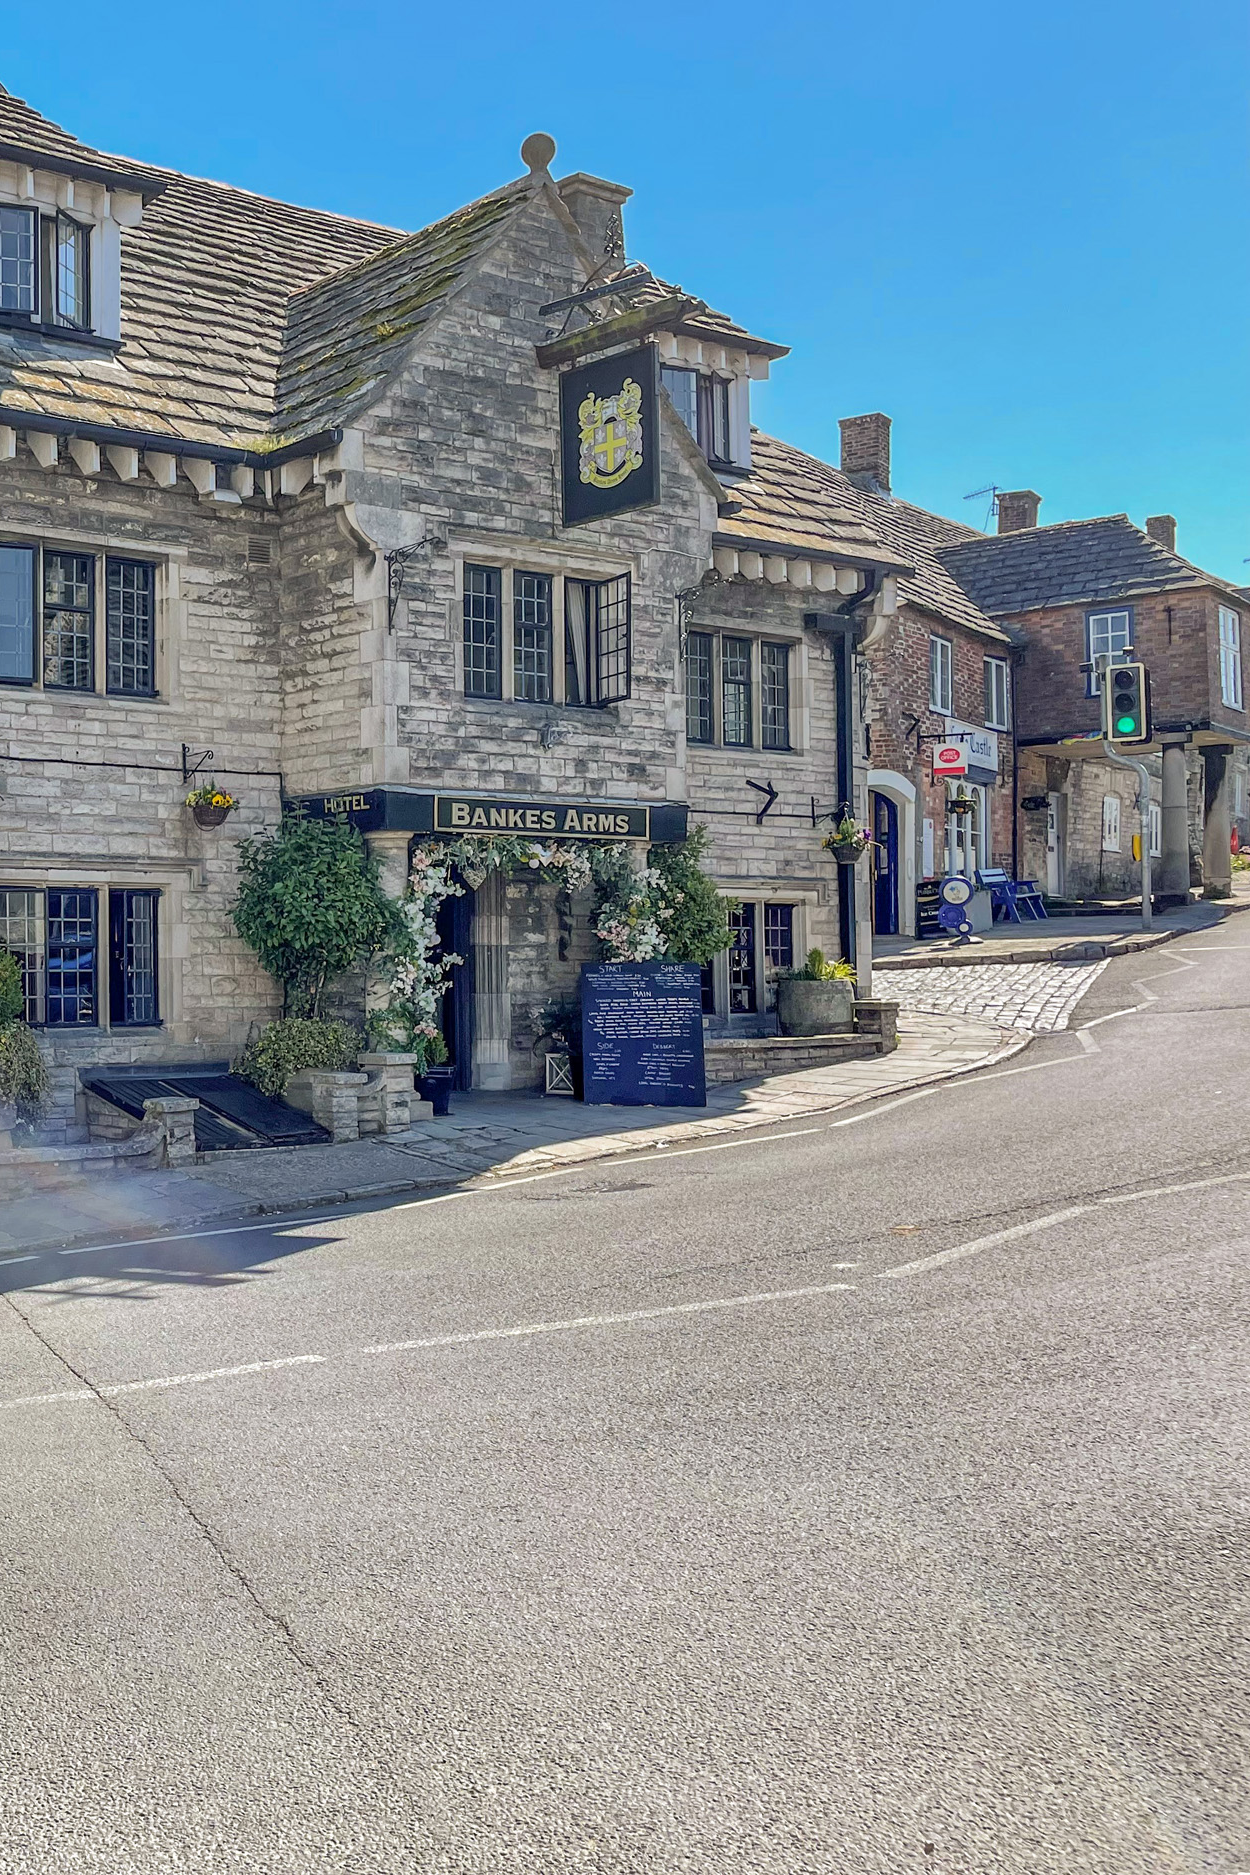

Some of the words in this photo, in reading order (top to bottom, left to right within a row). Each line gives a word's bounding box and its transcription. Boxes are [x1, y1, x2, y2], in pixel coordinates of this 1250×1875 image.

[324, 795, 370, 814] HOTEL
[450, 802, 557, 830] BANKES
[563, 808, 630, 834] ARMS
[599, 965, 622, 973] START
[660, 964, 685, 973] SHARE
[597, 1042, 614, 1050] SIDE
